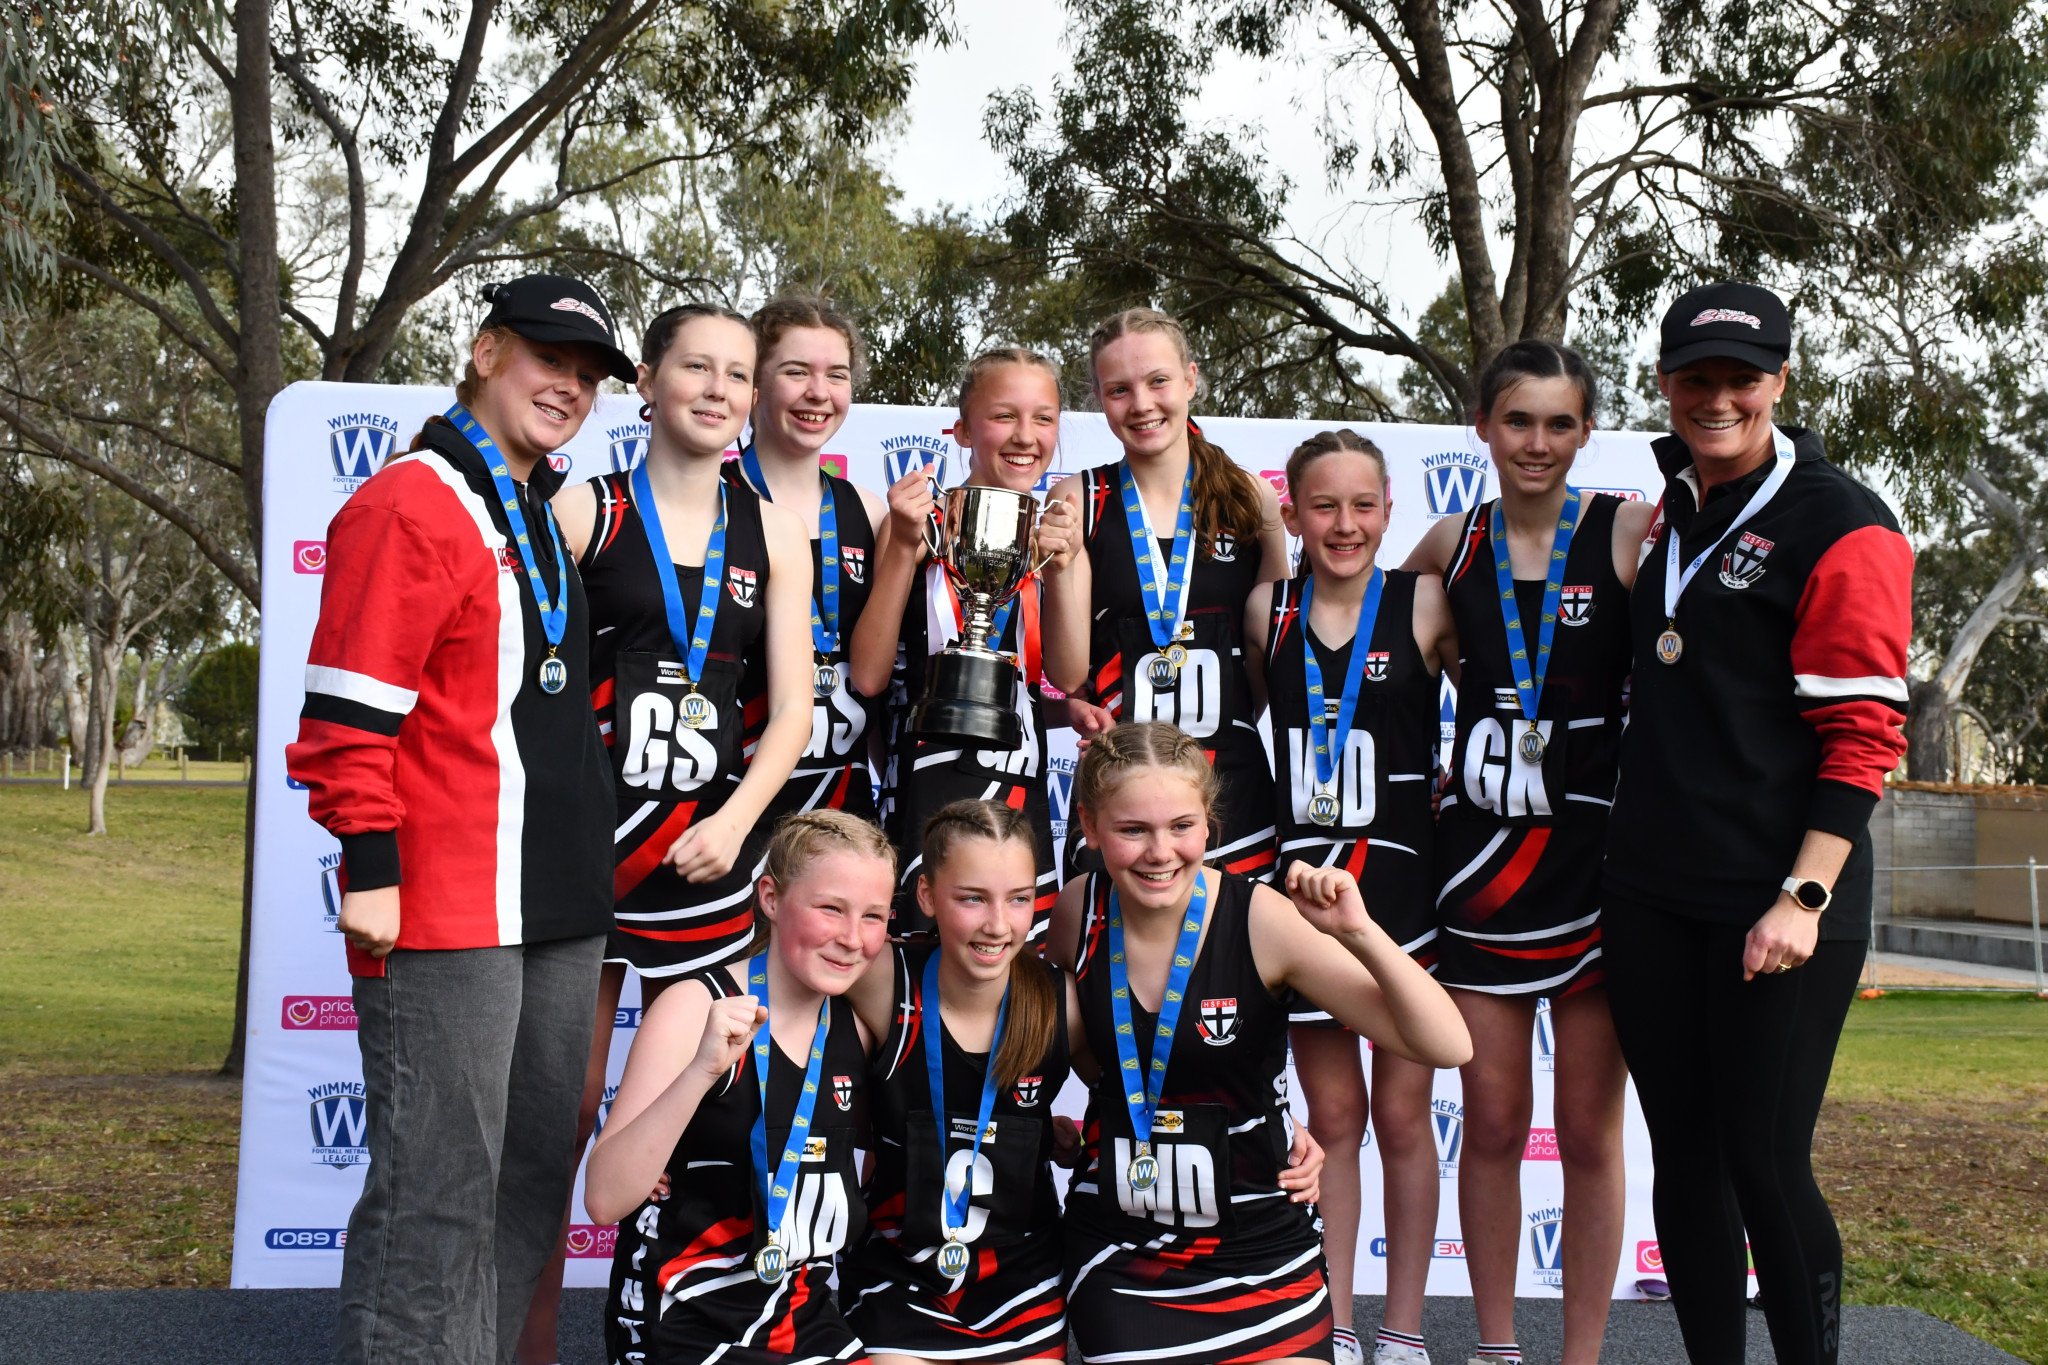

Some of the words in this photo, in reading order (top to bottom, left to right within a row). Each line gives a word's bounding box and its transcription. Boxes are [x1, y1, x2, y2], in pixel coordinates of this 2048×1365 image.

[327, 413, 398, 433] WIMMERA
[607, 424, 650, 440] WIMM
[880, 435, 949, 454] WIMMERA
[1421, 452, 1488, 471] WIMMERA
[1743, 533, 1773, 551] HSFNC
[547, 666, 559, 680] W
[820, 672, 832, 685] W
[1155, 665, 1168, 676] W
[1134, 648, 1220, 738] GD
[687, 702, 701, 715] W
[622, 692, 718, 791] GS
[1463, 717, 1553, 817] GK
[1288, 728, 1375, 827] WD
[1317, 802, 1331, 814] W
[1203, 1000, 1234, 1008] HSFNC
[308, 1082, 366, 1099] WIMME
[1137, 1164, 1151, 1176] W
[1115, 1137, 1220, 1228] WD
[941, 1149, 993, 1243] C
[273, 1232, 330, 1246] 1089
[765, 1254, 779, 1267] W
[946, 1251, 961, 1263] W
